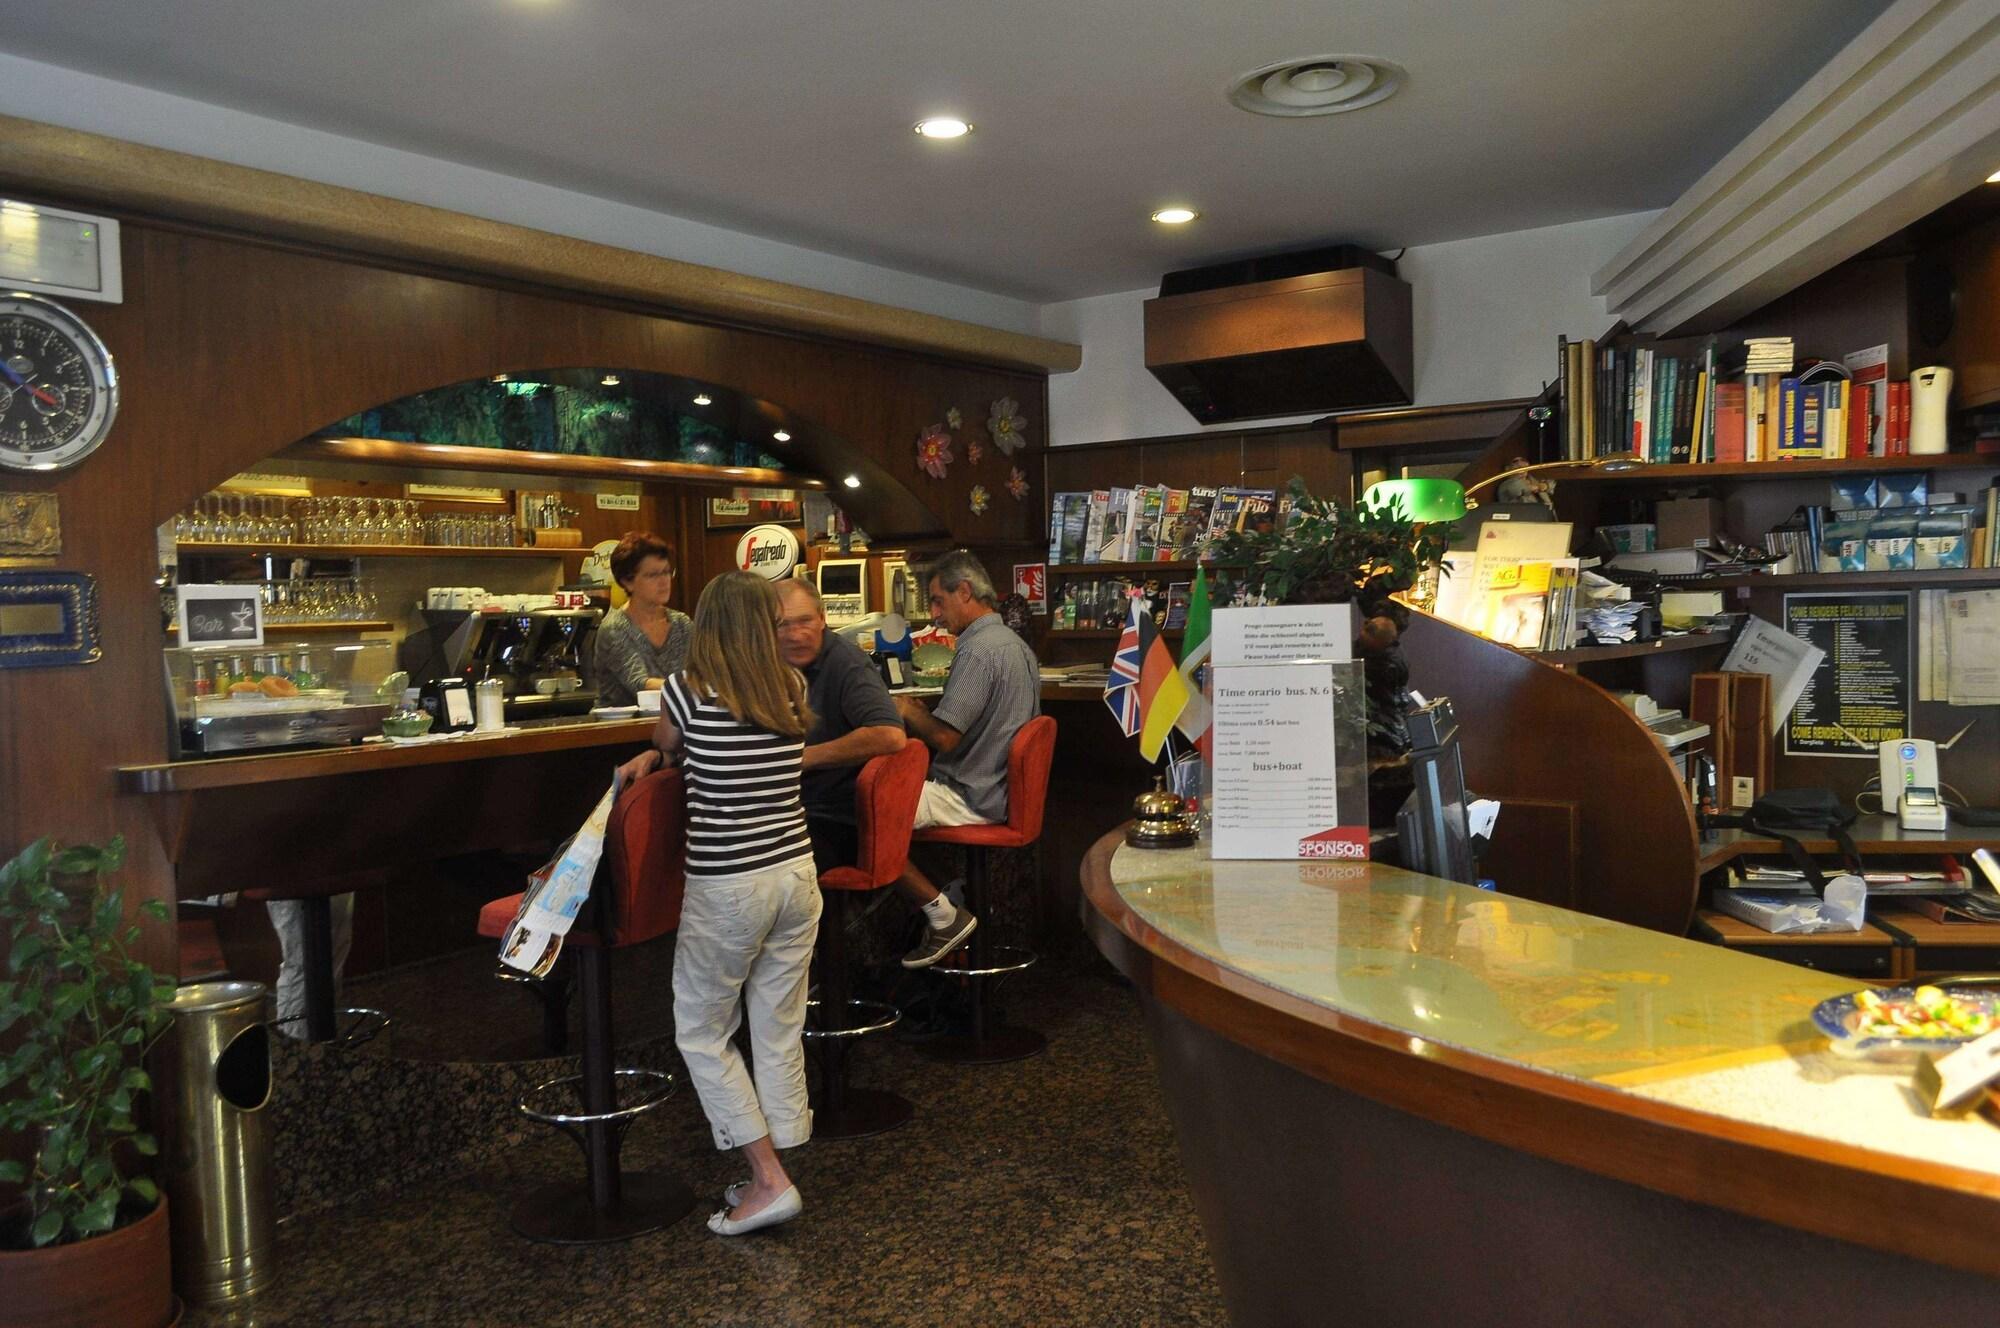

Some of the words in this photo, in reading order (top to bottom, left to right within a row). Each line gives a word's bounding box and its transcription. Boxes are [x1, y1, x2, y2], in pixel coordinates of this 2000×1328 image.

[742, 536, 787, 570] Segafredo
[191, 614, 225, 633] Bar
[1218, 688, 1246, 697] Time
[1248, 688, 1281, 697] orario
[1286, 687, 1308, 696] bus.
[1310, 687, 1321, 696] N.
[1323, 686, 1329, 695] 6
[1791, 726, 1811, 740] COME
[1813, 726, 1844, 741] RENDERE
[1869, 728, 1880, 741] UN
[1881, 728, 1904, 742] UOMO
[1252, 761, 1303, 772] bus+boat
[1298, 842, 1365, 858] SPONSOR
